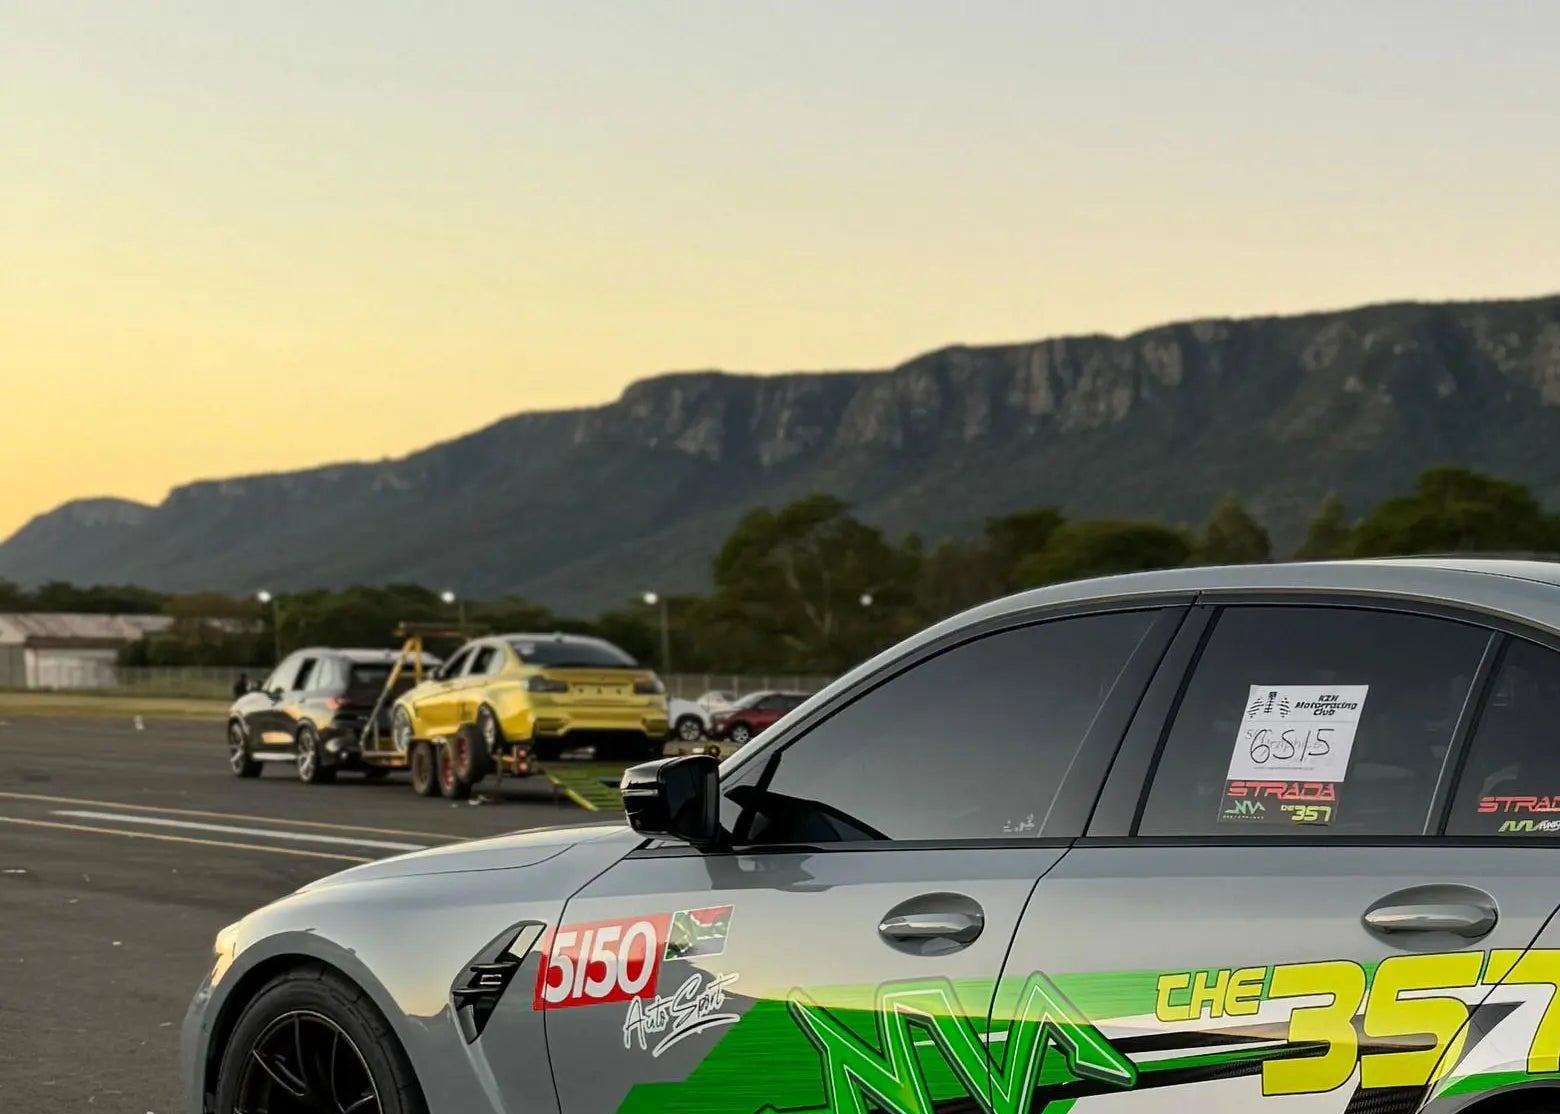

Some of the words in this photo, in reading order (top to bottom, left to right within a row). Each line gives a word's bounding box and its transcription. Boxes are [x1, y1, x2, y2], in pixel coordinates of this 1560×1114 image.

[1227, 781, 1336, 801] STRADA
[1291, 805, 1332, 822] 357
[1155, 967, 1269, 1022] THE
